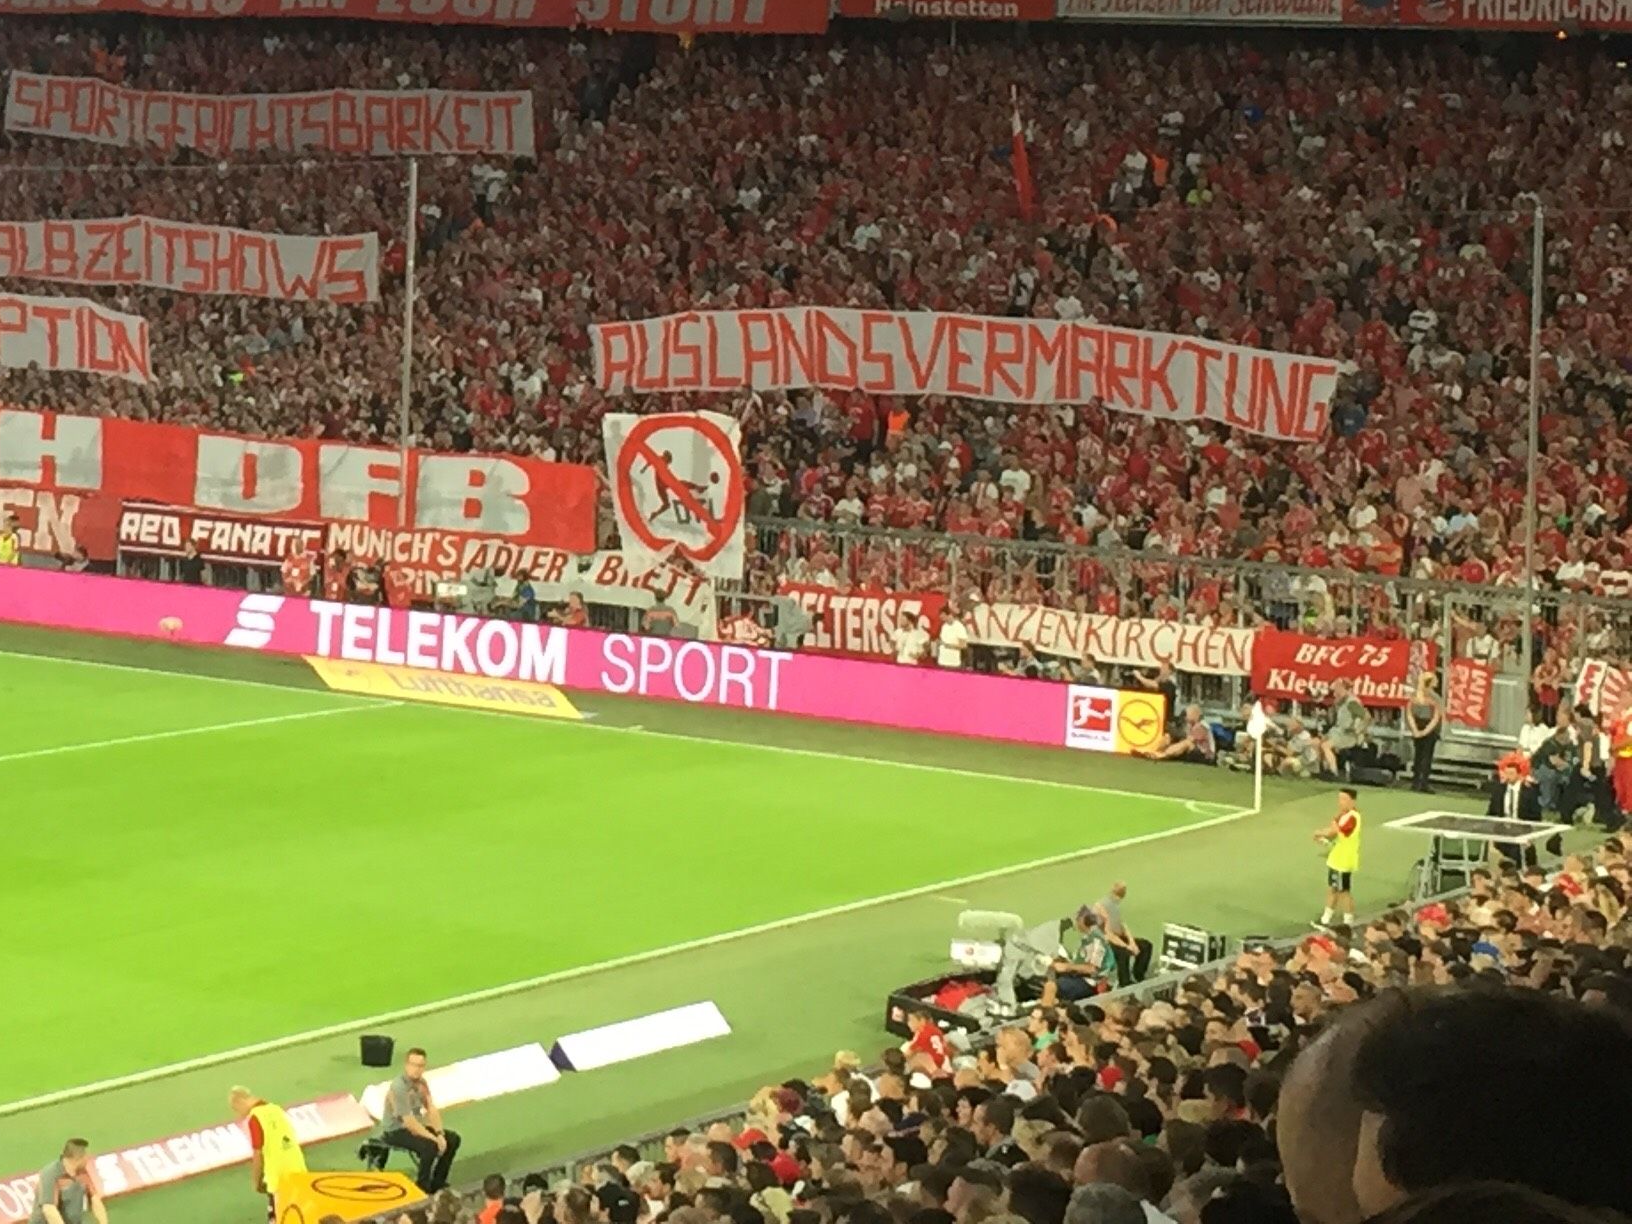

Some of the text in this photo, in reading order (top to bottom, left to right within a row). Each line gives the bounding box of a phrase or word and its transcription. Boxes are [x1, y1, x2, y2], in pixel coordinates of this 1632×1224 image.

[599, 309, 1336, 441] AUSLANDSVERMARKTUNG
[194, 433, 531, 535] DFB
[309, 600, 794, 711] TELEKOM SPORT
[387, 669, 557, 710] Lufthansa
[1295, 643, 1392, 668] BFC 75
